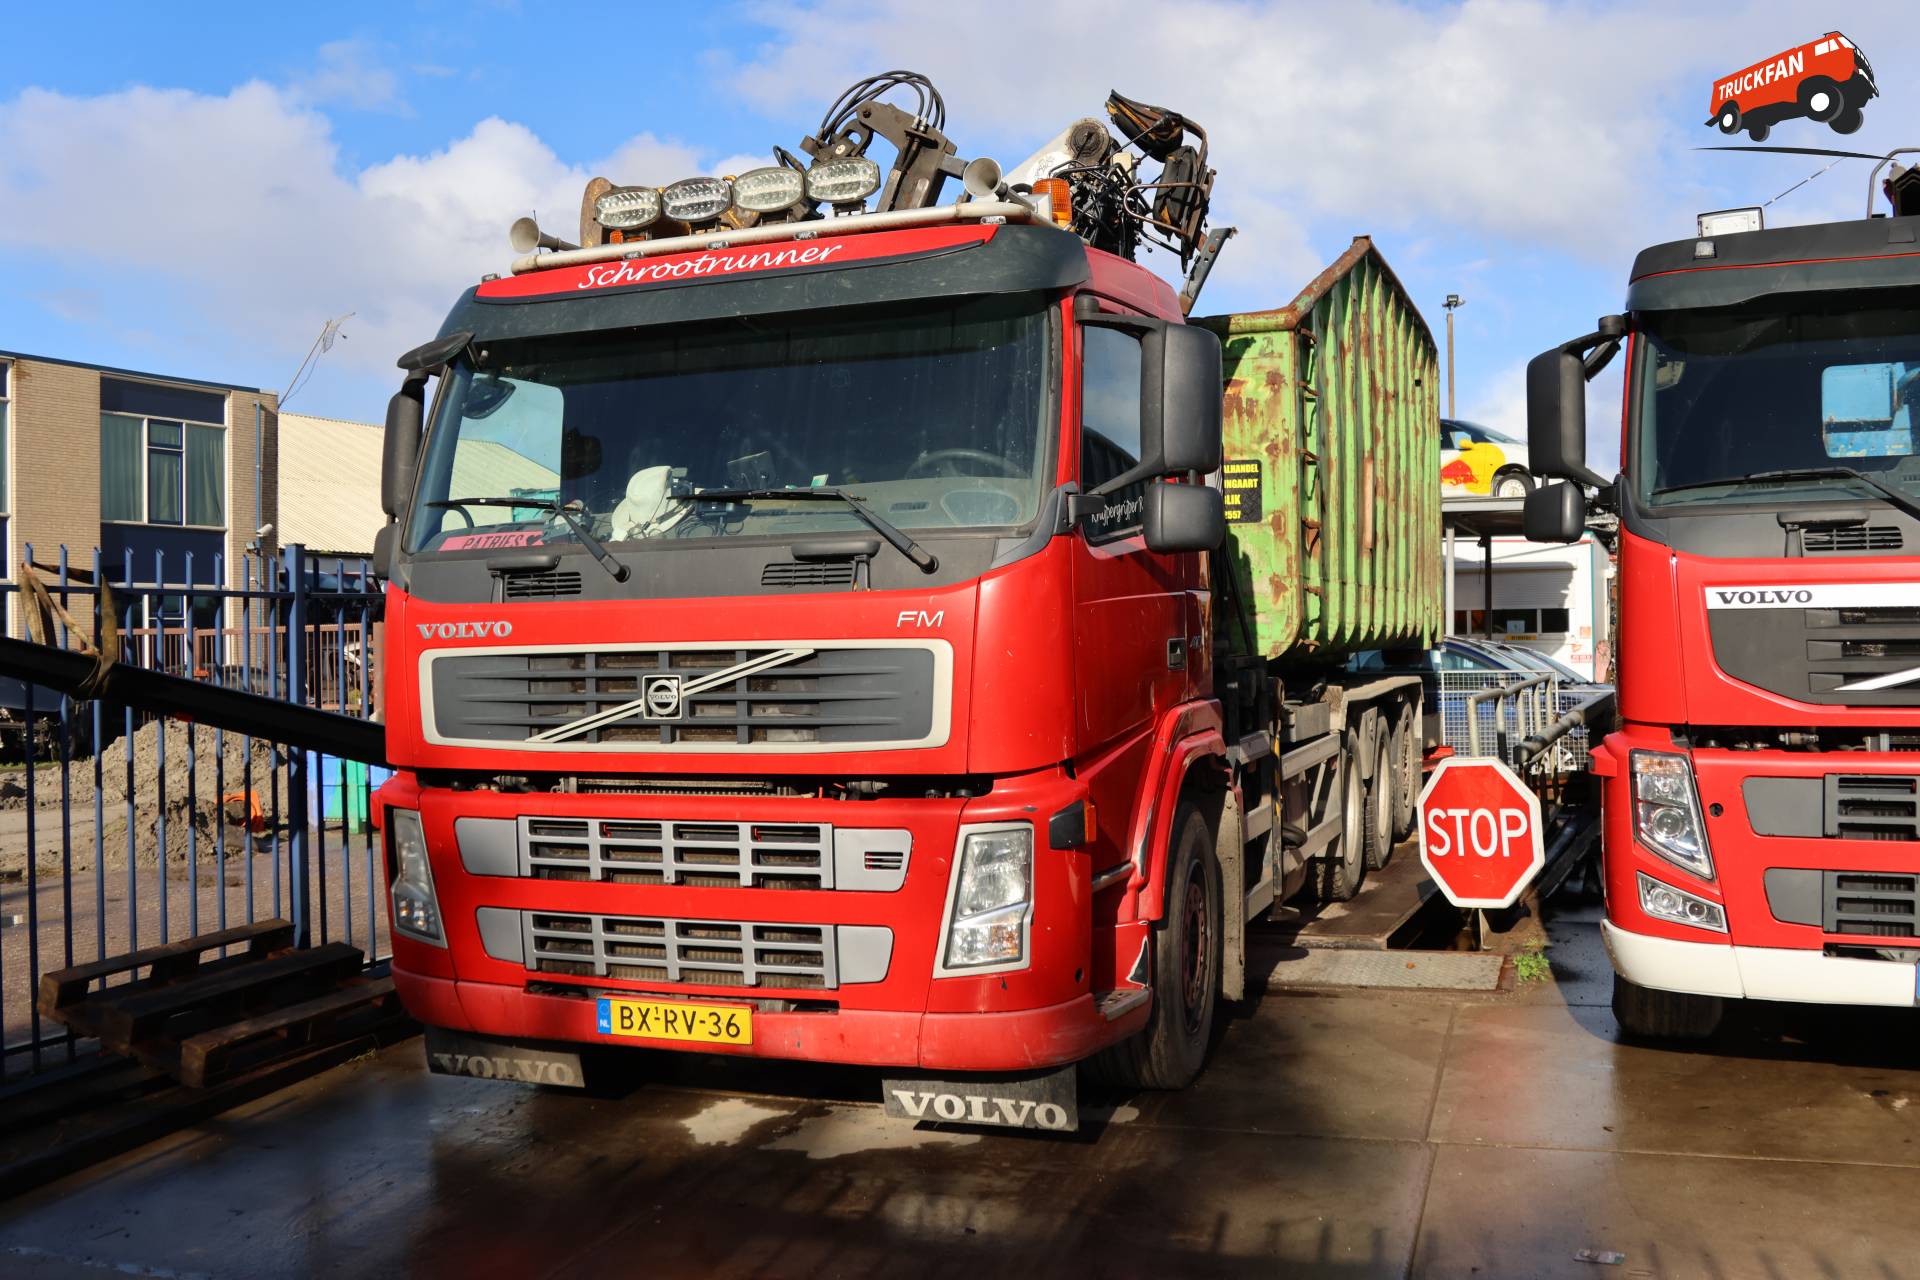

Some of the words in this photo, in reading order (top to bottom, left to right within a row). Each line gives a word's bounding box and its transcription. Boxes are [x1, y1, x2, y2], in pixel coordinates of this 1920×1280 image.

[578, 244, 842, 289] Schrootrunner
[1716, 590, 1813, 604] VOLVO
[416, 620, 513, 640] VOLVO
[896, 610, 944, 628] FM
[1428, 808, 1528, 857] STOP
[433, 1053, 576, 1084] VOLVO
[892, 1089, 1068, 1129] VOLVO
